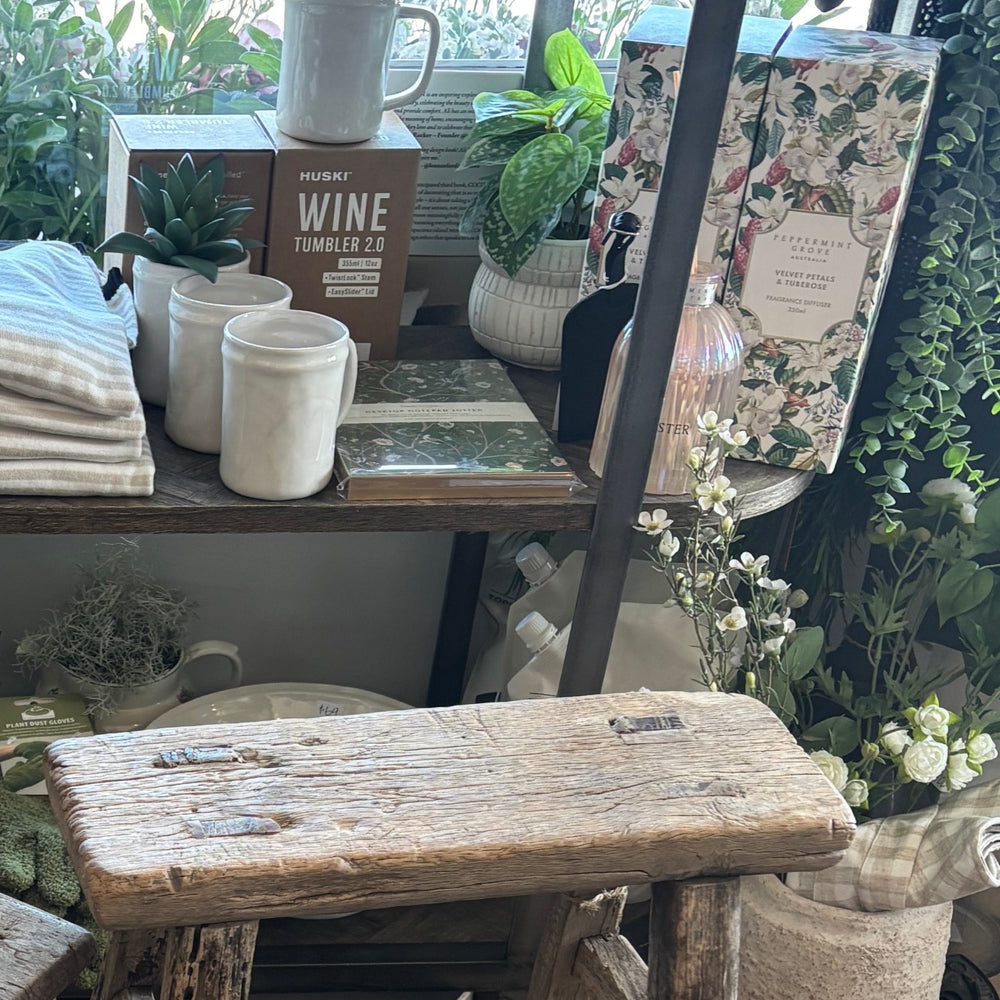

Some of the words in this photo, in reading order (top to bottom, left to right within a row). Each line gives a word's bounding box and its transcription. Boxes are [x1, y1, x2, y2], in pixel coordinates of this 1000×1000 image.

[299, 193, 390, 231] WINE
[294, 237, 360, 252] TUMBLER
[364, 237, 384, 252] 2.0
[773, 234, 852, 250] PEPPERMINT
[791, 245, 831, 256] GROVE
[790, 255, 827, 263] AUSTRALIA
[775, 269, 804, 279] VELVET
[805, 272, 836, 283] PETALS
[776, 278, 783, 286] &
[785, 279, 828, 291] TUBEROSE
[766, 294, 802, 305] FRAGRANCE
[803, 299, 832, 309] DIFFUSER
[657, 422, 690, 435] STER
[6, 721, 29, 729] PLANT
[49, 717, 76, 725] GLOVES
